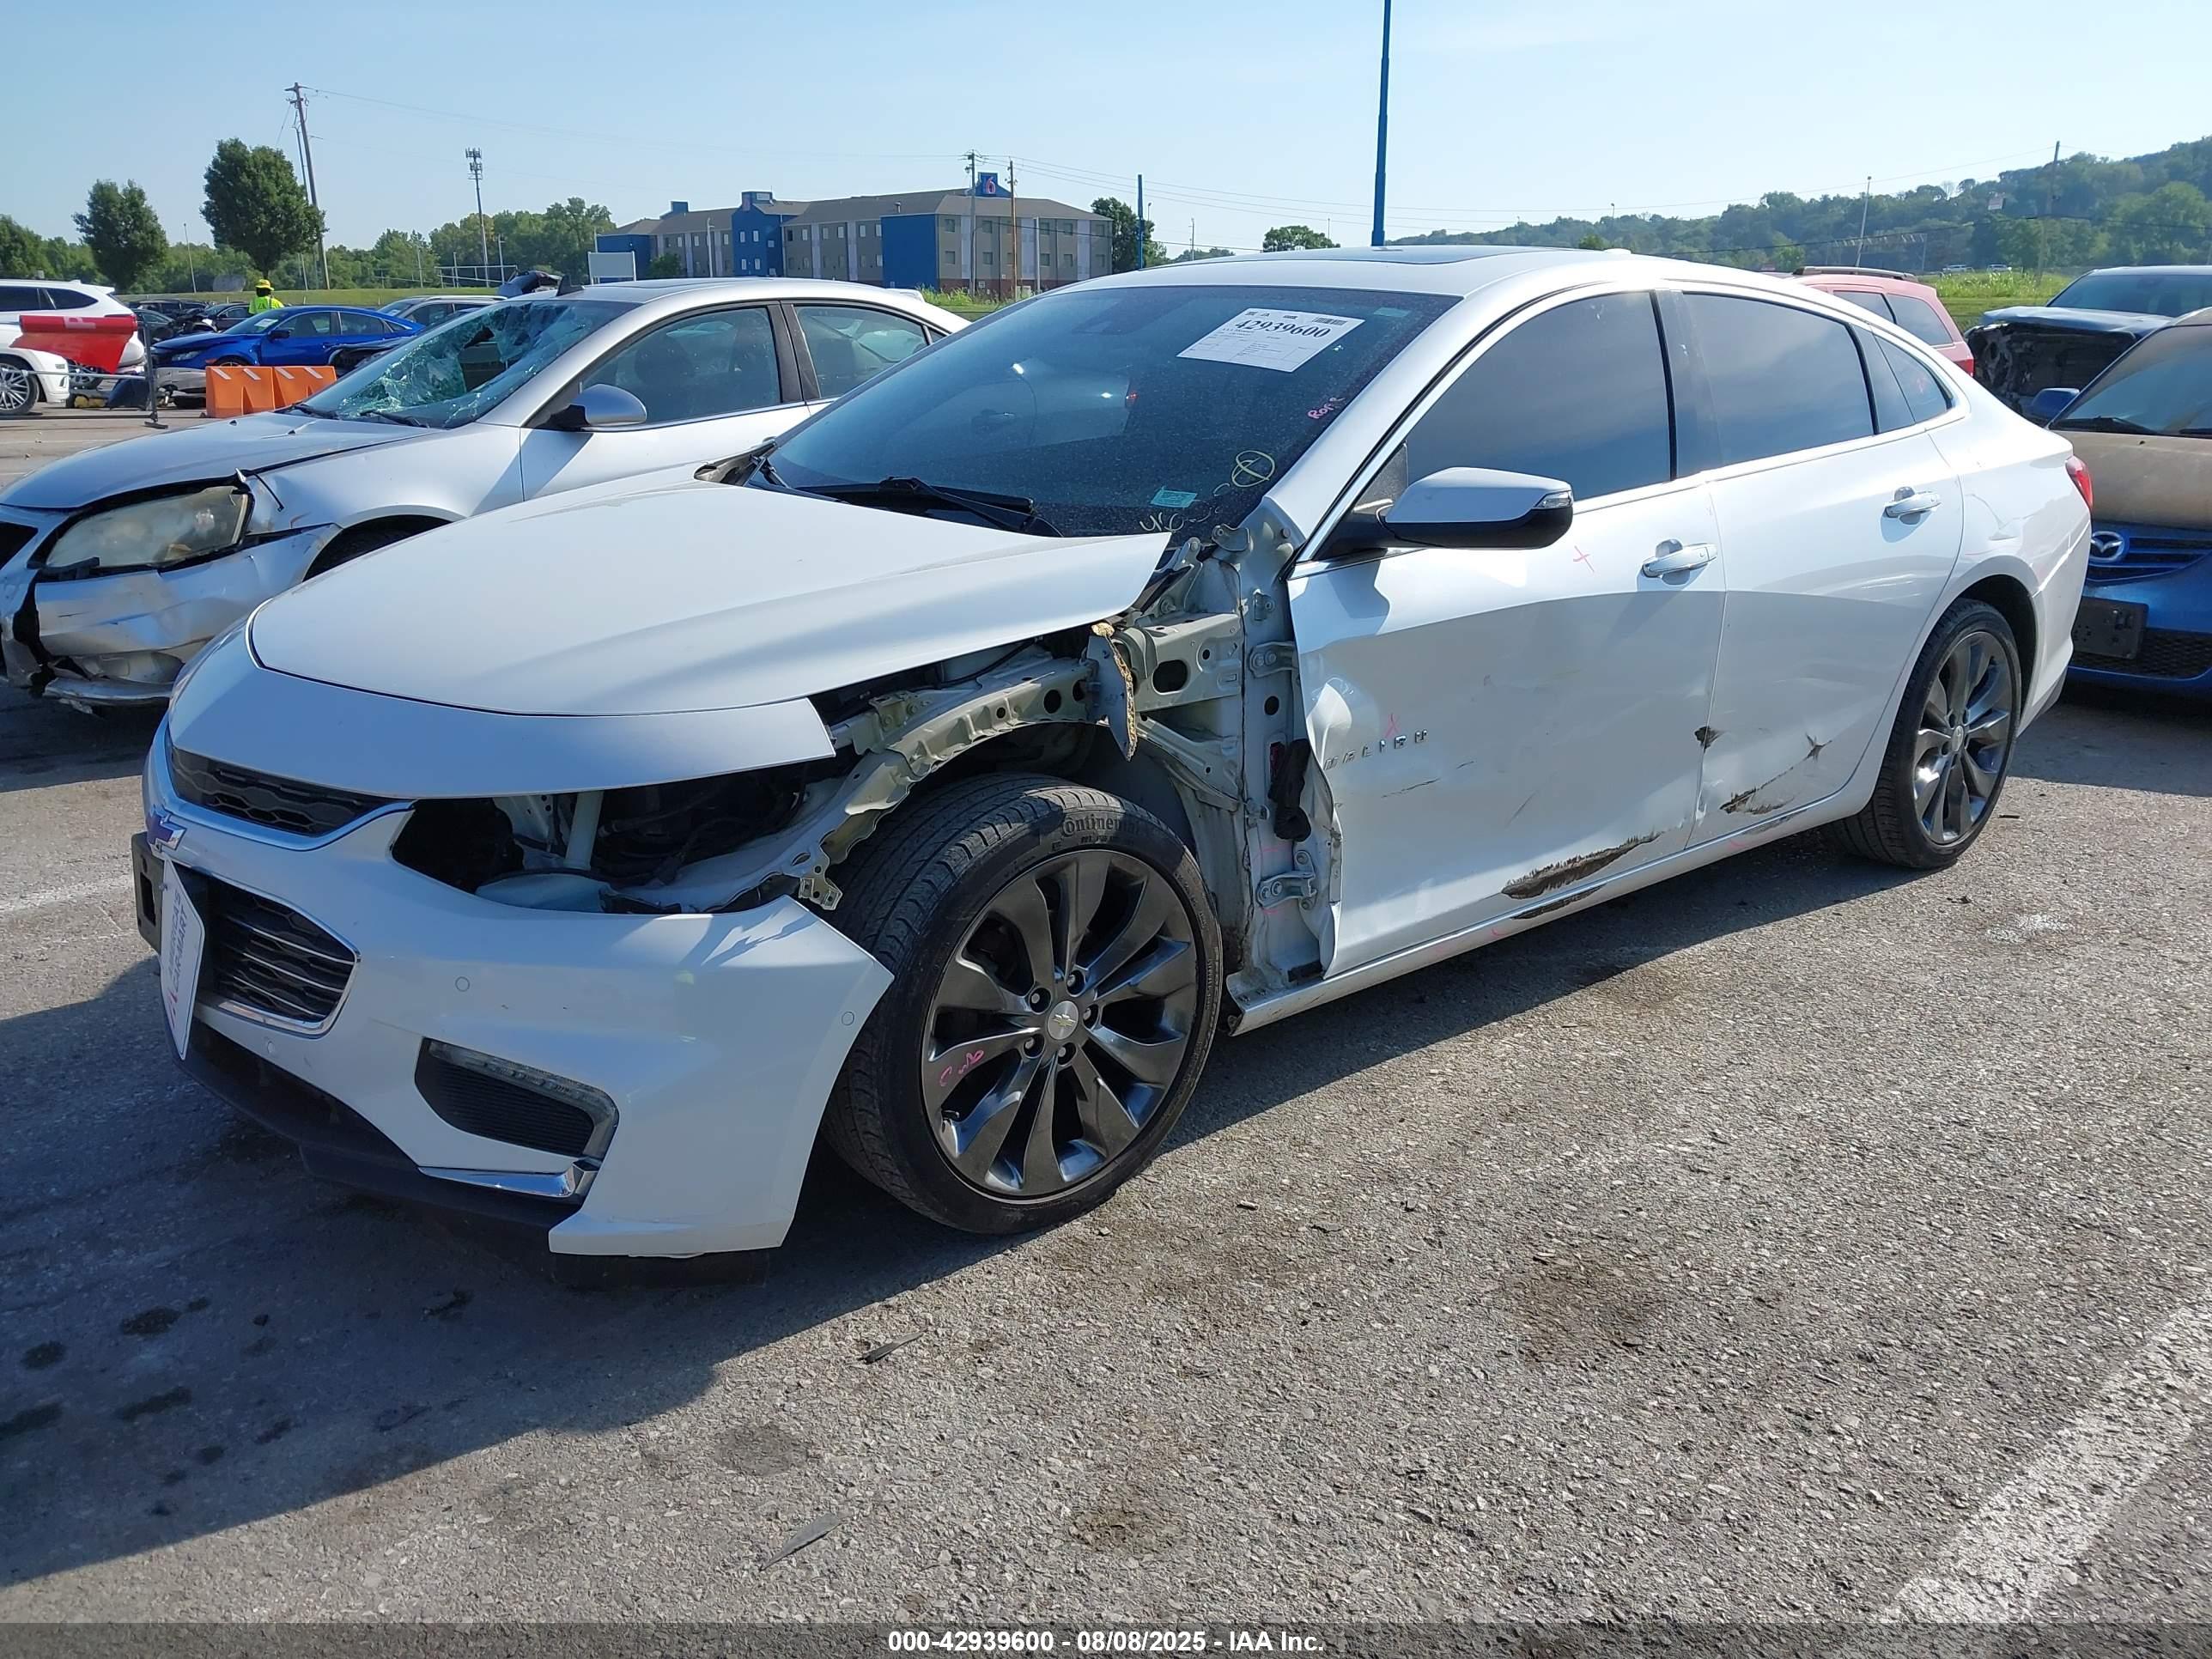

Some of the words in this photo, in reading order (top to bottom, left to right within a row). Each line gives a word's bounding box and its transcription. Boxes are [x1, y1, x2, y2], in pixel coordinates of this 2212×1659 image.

[986, 176, 996, 194] 6
[1235, 319, 1331, 339] 42939600
[1323, 728, 1429, 771] MALIBU
